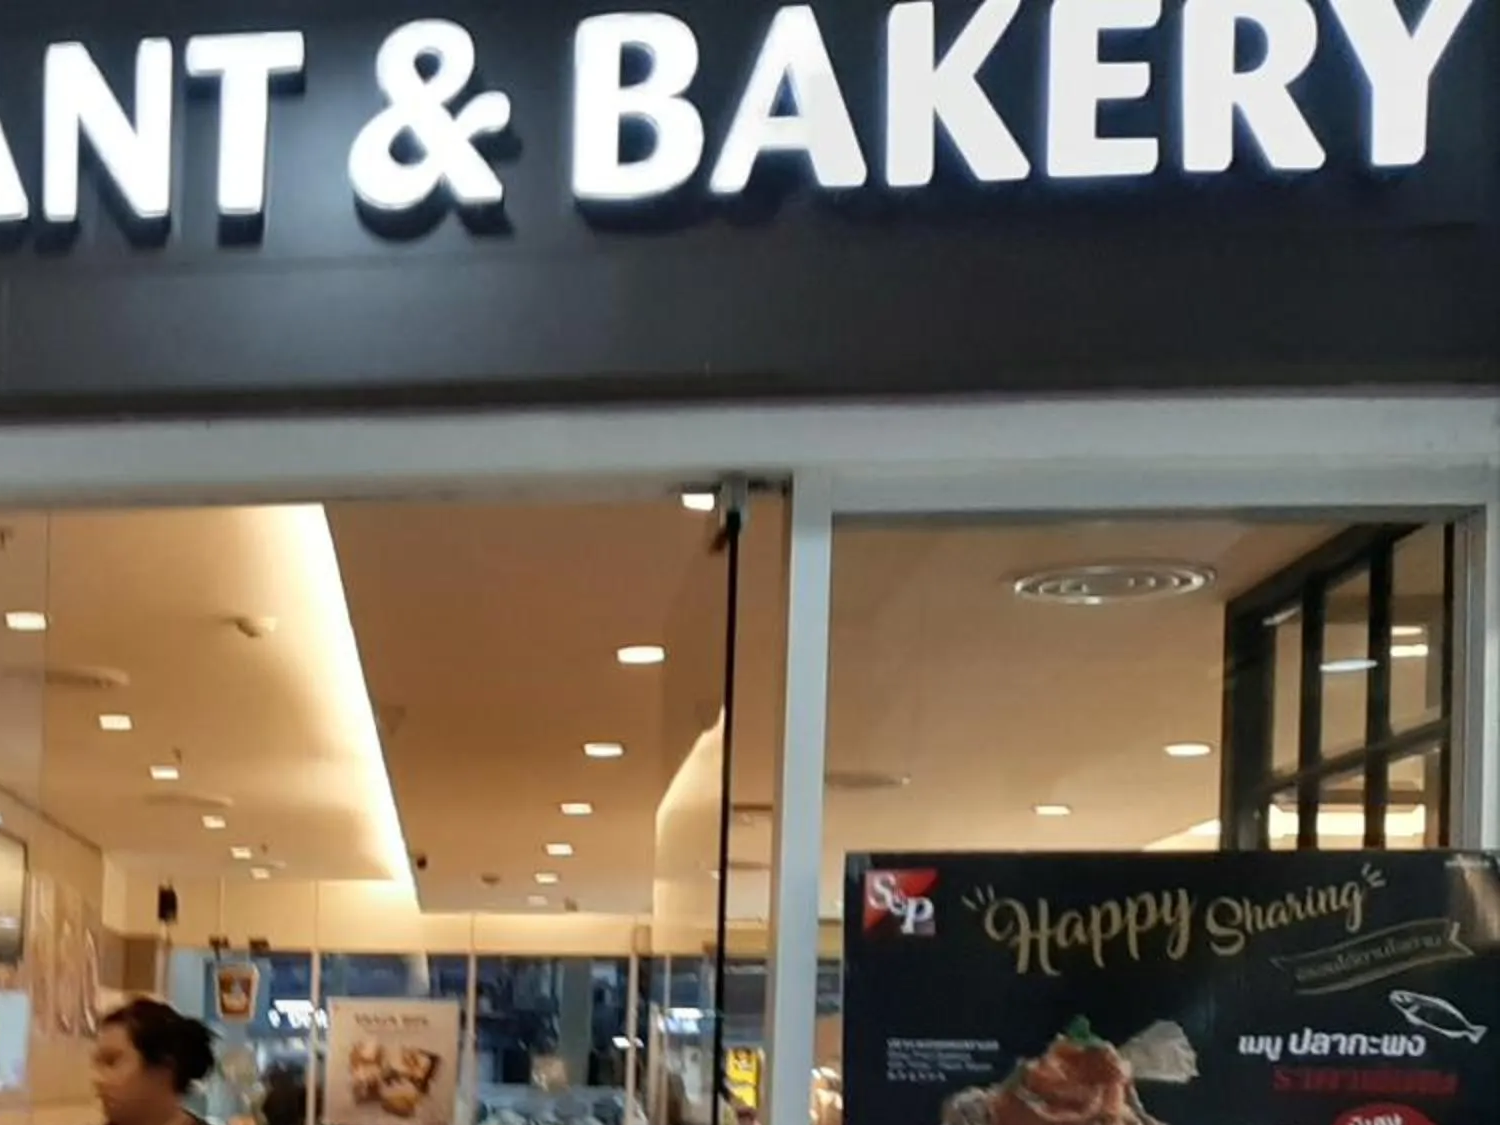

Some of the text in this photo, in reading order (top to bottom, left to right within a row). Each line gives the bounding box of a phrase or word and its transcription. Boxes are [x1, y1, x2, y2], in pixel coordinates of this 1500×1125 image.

[348, 19, 511, 211] &
[571, 0, 1476, 201] BAKERY
[866, 872, 935, 934] S&P
[985, 888, 1191, 977] Happy
[1206, 881, 1363, 957] Sharing
